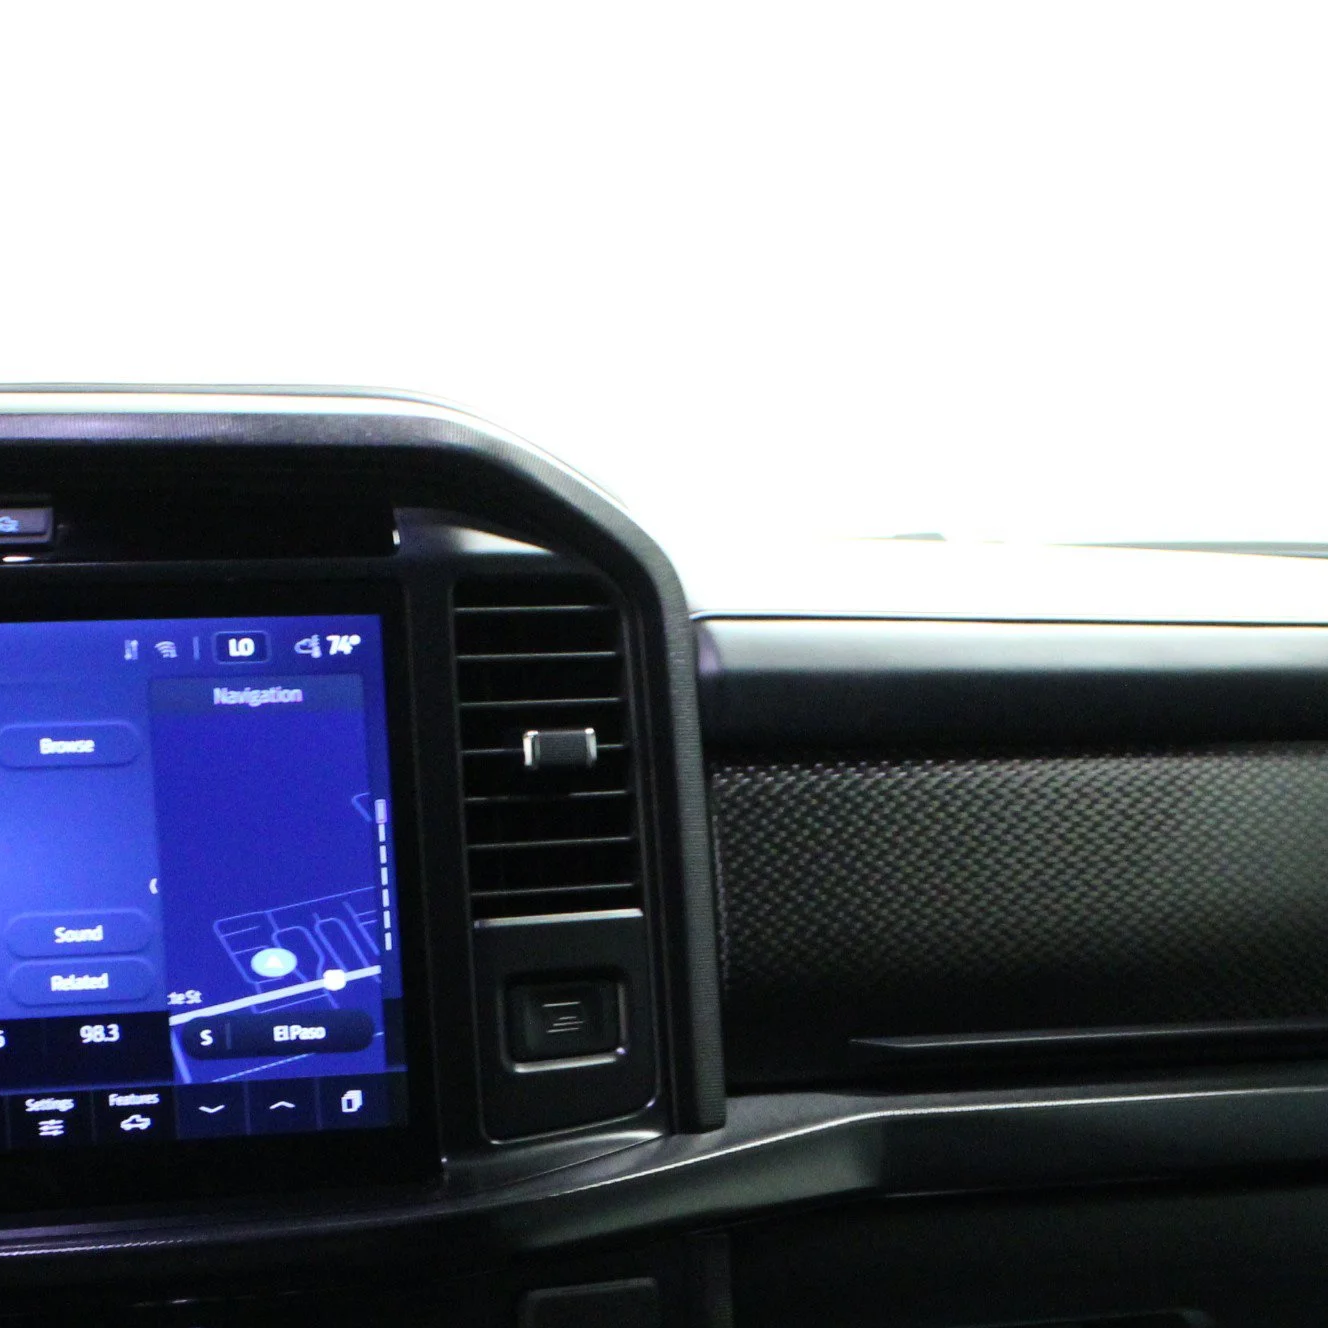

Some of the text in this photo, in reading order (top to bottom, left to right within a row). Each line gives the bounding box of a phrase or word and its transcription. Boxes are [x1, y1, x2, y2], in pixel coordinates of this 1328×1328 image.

[228, 637, 255, 658] LO
[326, 634, 361, 655] 74°
[213, 686, 303, 708] Navigation
[39, 737, 96, 755] Browse
[54, 925, 104, 943] Sound
[50, 973, 109, 992] Related
[80, 1024, 120, 1044] 98.3
[199, 1025, 326, 1046] S El Paso
[25, 1096, 74, 1113] Settings
[109, 1091, 160, 1107] Features
